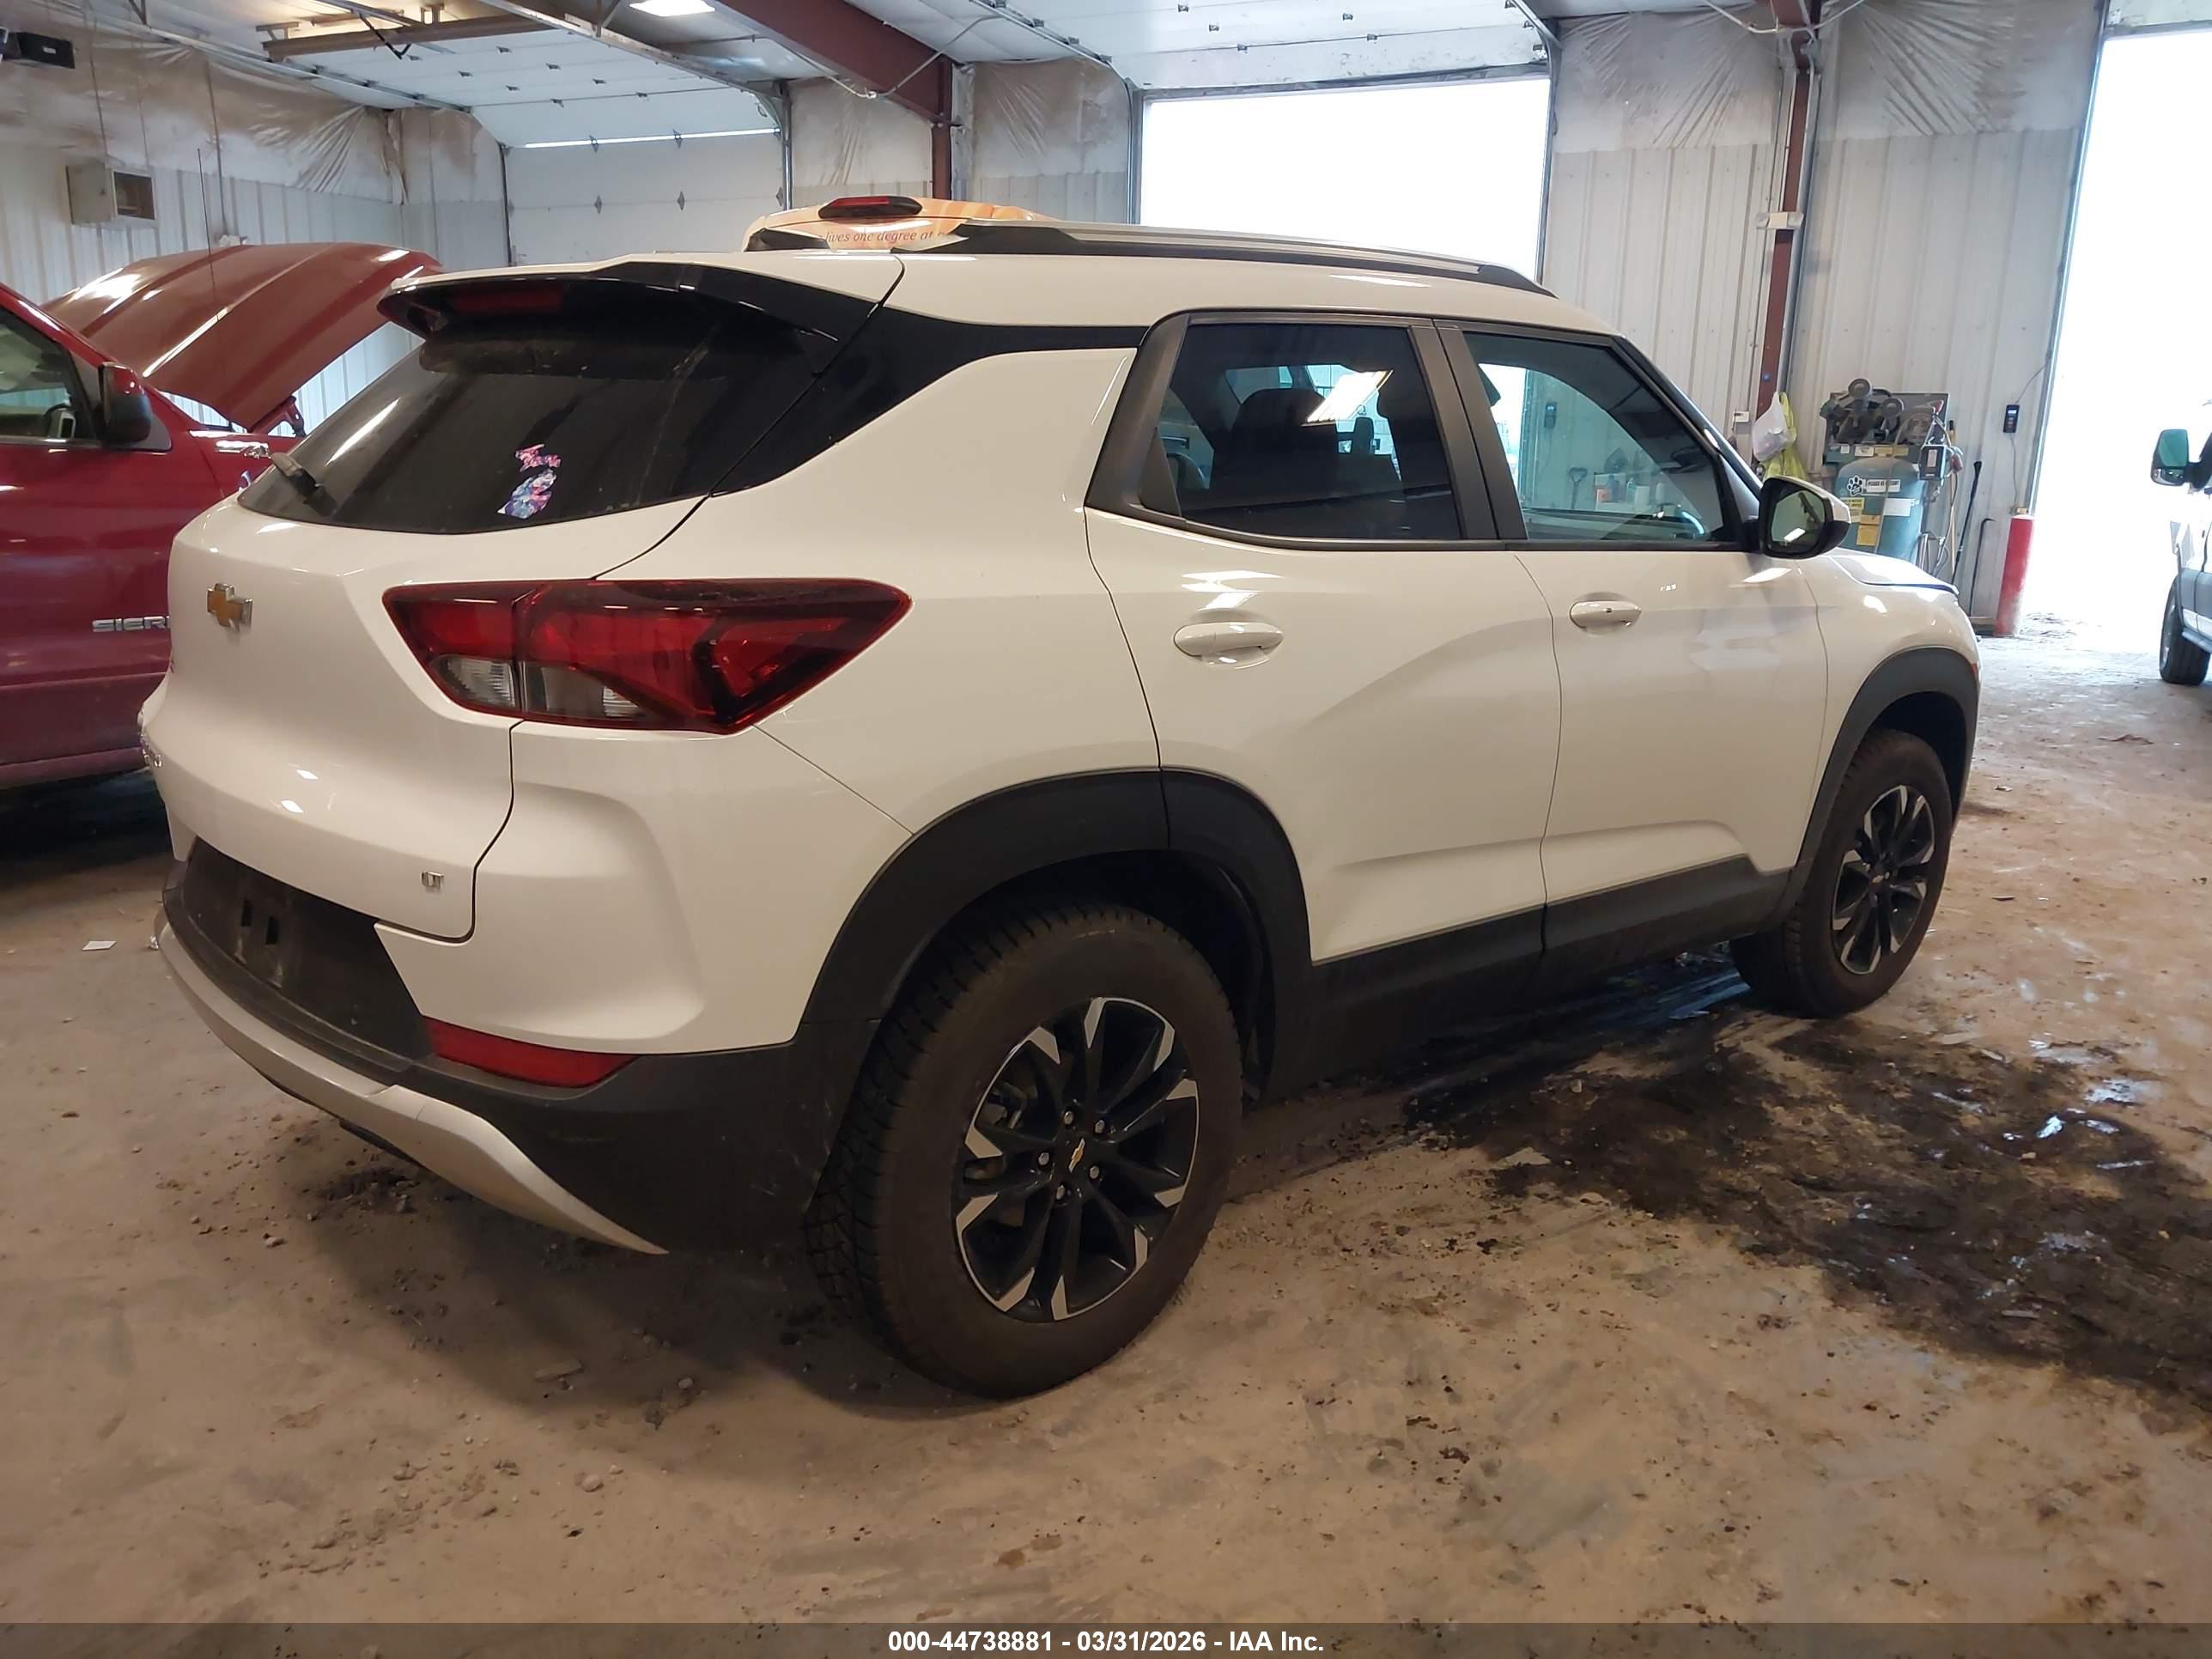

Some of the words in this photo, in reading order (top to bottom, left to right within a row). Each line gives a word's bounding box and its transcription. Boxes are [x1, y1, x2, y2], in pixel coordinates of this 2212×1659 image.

[854, 233, 874, 241] one
[877, 230, 917, 244] degree
[920, 231, 933, 240] at
